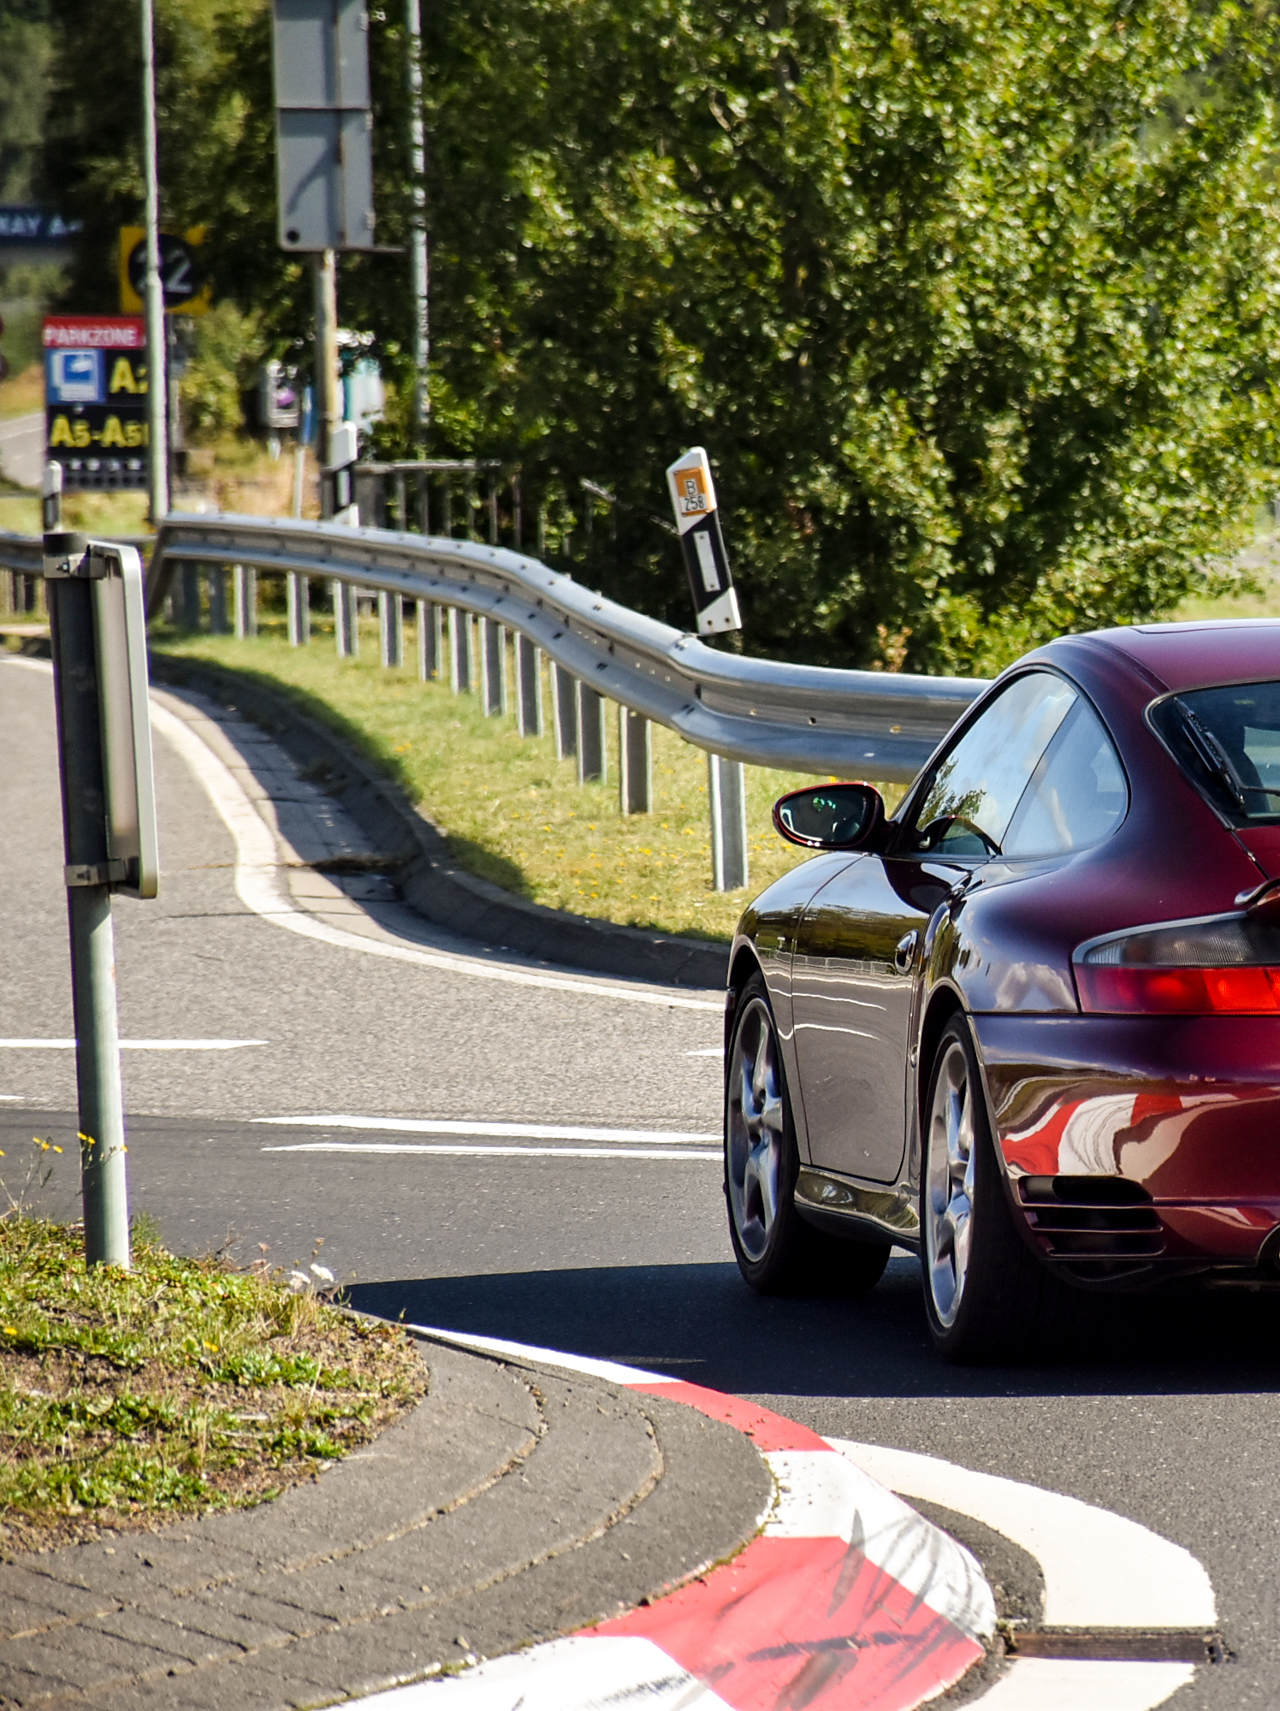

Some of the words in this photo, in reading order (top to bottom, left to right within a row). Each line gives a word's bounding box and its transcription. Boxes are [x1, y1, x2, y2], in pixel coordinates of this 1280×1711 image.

[44, 324, 138, 347] PARKZONE
[685, 480, 696, 495] B
[684, 495, 705, 512] 258
